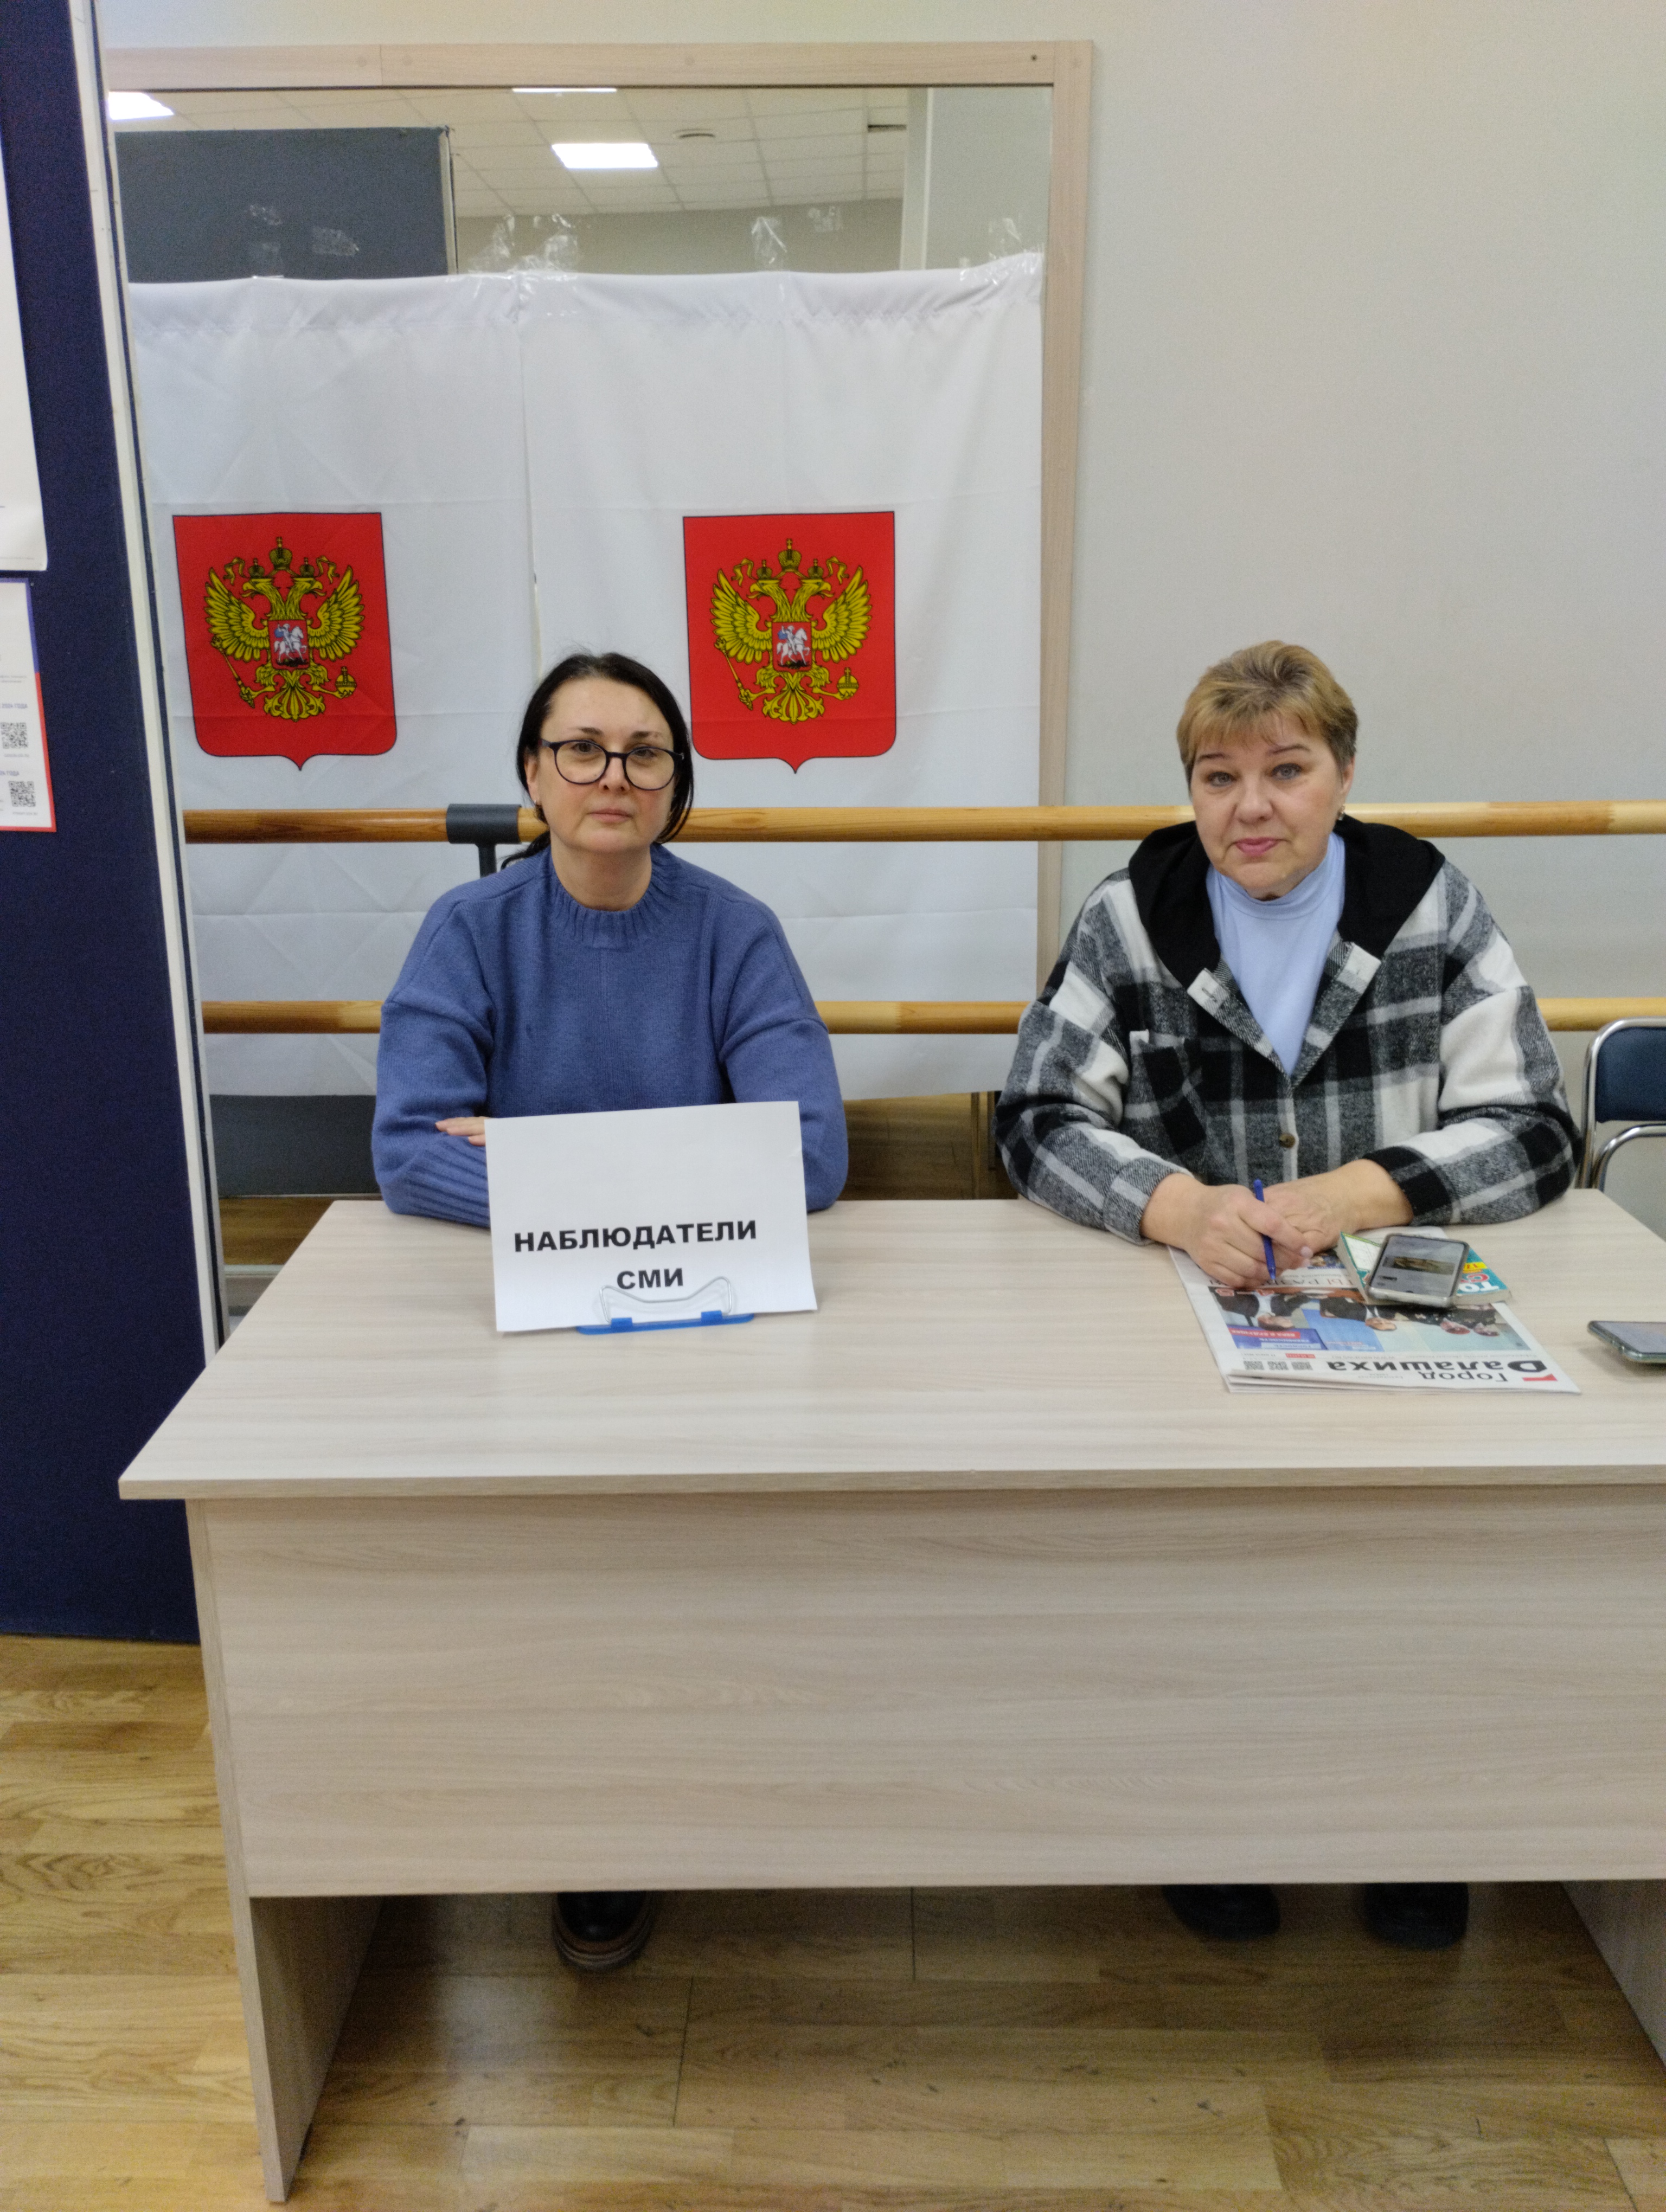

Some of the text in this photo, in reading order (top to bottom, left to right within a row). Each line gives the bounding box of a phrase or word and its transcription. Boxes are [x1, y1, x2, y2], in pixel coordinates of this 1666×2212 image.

[515, 1220, 757, 1252] НАБЛЮДАТЕЛИ
[617, 1268, 683, 1290] СМИ
[1419, 1371, 1508, 1382] Город
